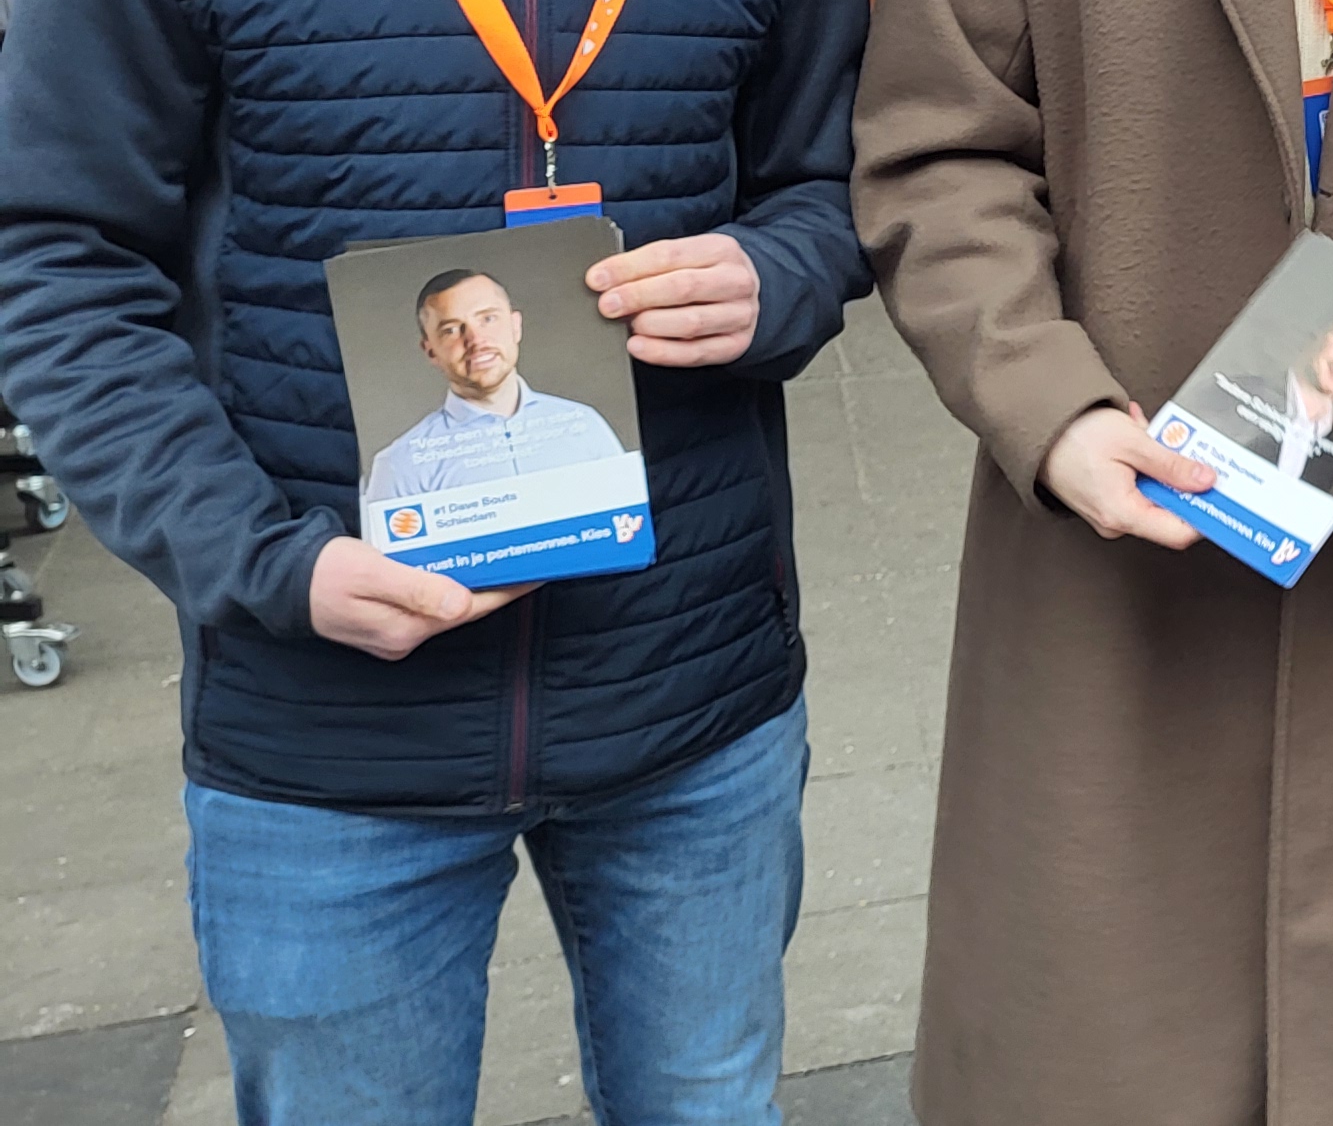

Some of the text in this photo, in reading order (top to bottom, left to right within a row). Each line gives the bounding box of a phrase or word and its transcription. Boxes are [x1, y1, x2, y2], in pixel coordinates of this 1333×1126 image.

[427, 557, 455, 573] rust
[456, 555, 470, 567] in
[470, 552, 485, 567] je
[581, 528, 612, 542] Kies
